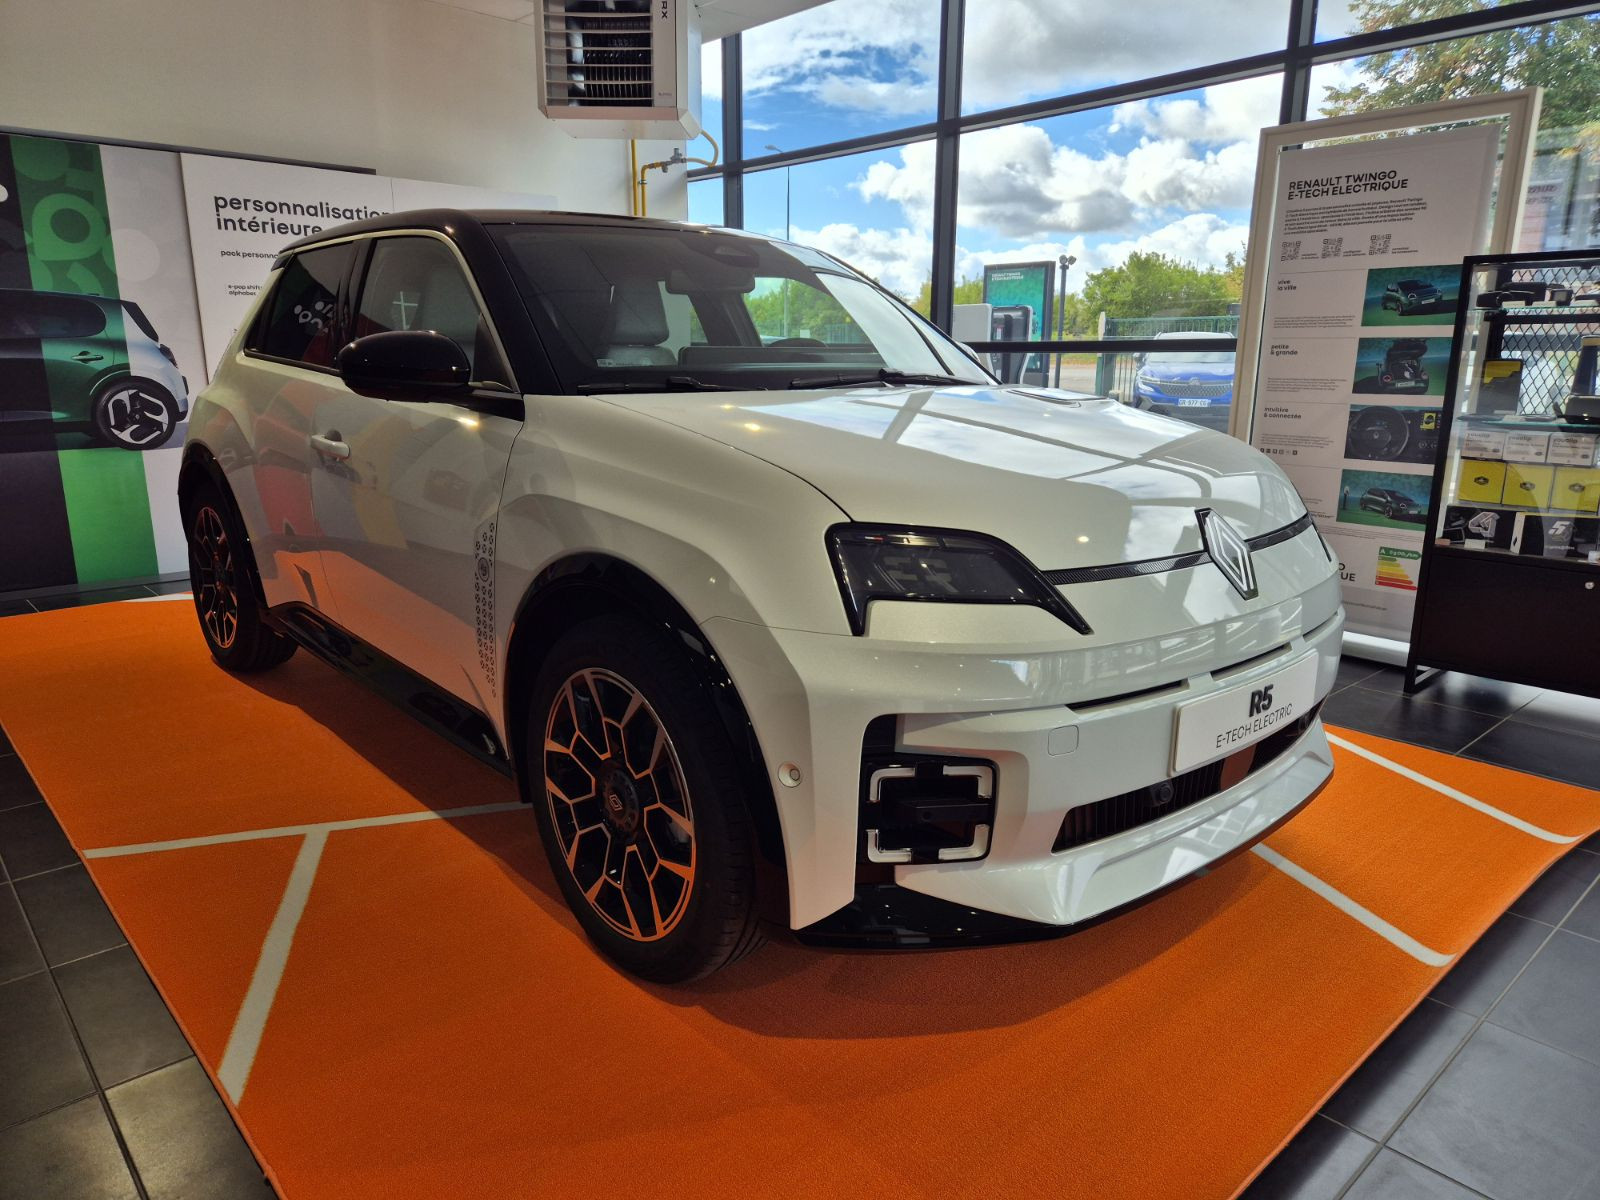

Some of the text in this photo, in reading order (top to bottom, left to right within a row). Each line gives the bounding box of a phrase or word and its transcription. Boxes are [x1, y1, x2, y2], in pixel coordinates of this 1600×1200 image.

[1288, 170, 1397, 190] RENAULT TWINGO
[1288, 179, 1408, 200] E-TECH ELECTRIQUE
[216, 213, 322, 236] intérieure
[220, 250, 241, 258] pack
[1249, 684, 1274, 718] R5
[1216, 703, 1293, 749] E-TECH ELECTRIC
